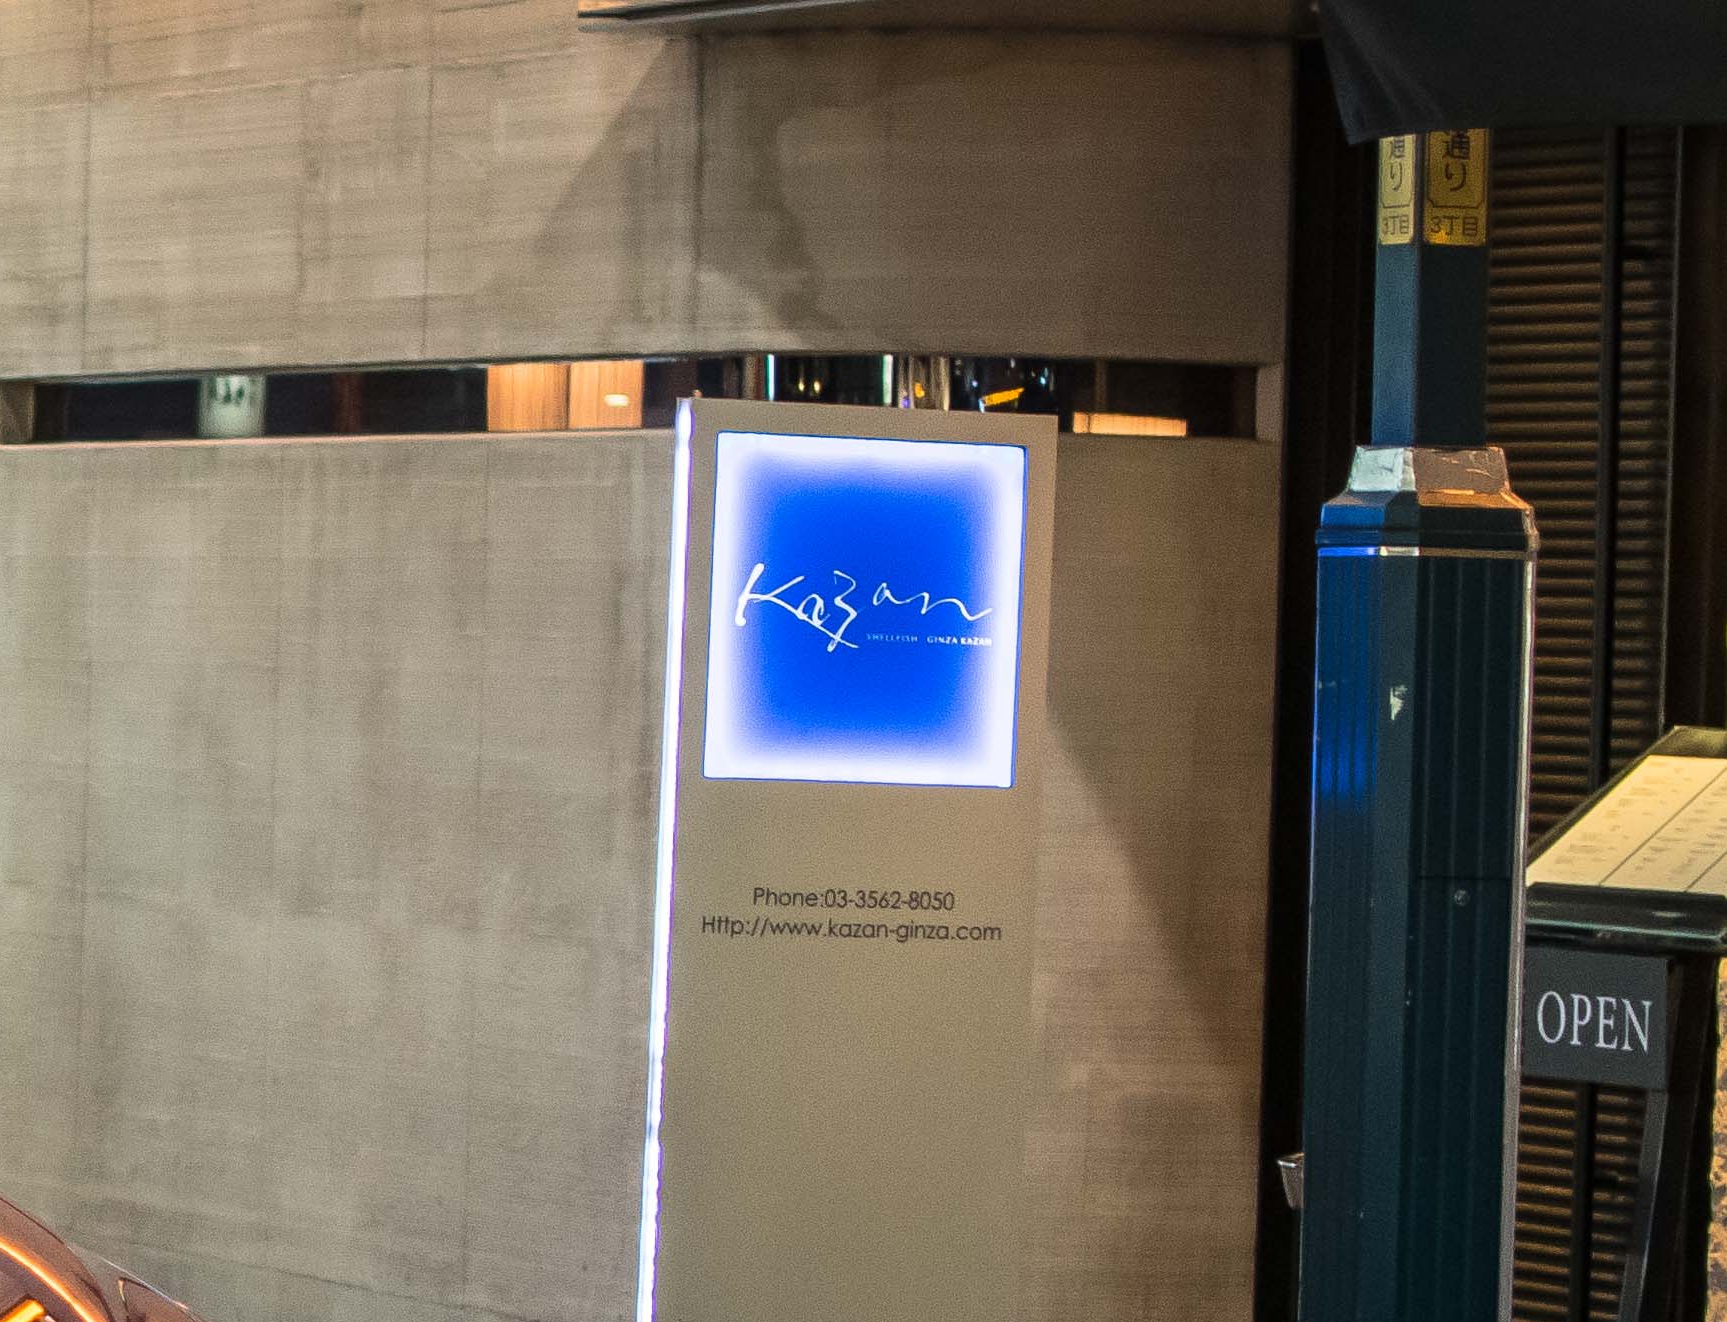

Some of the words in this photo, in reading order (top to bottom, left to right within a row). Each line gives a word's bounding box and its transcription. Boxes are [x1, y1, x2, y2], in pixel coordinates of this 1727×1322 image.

[1442, 130, 1470, 191] 通り
[1429, 215, 1478, 238] 3丁目
[734, 563, 993, 652] Kazan
[927, 633, 959, 646] GINZA
[960, 636, 993, 648] KAZAN
[752, 886, 956, 912] Phone:03-3562-8050
[701, 915, 1003, 943] Http://www.kazan-ginza.com
[1537, 990, 1652, 1053] OPEN
